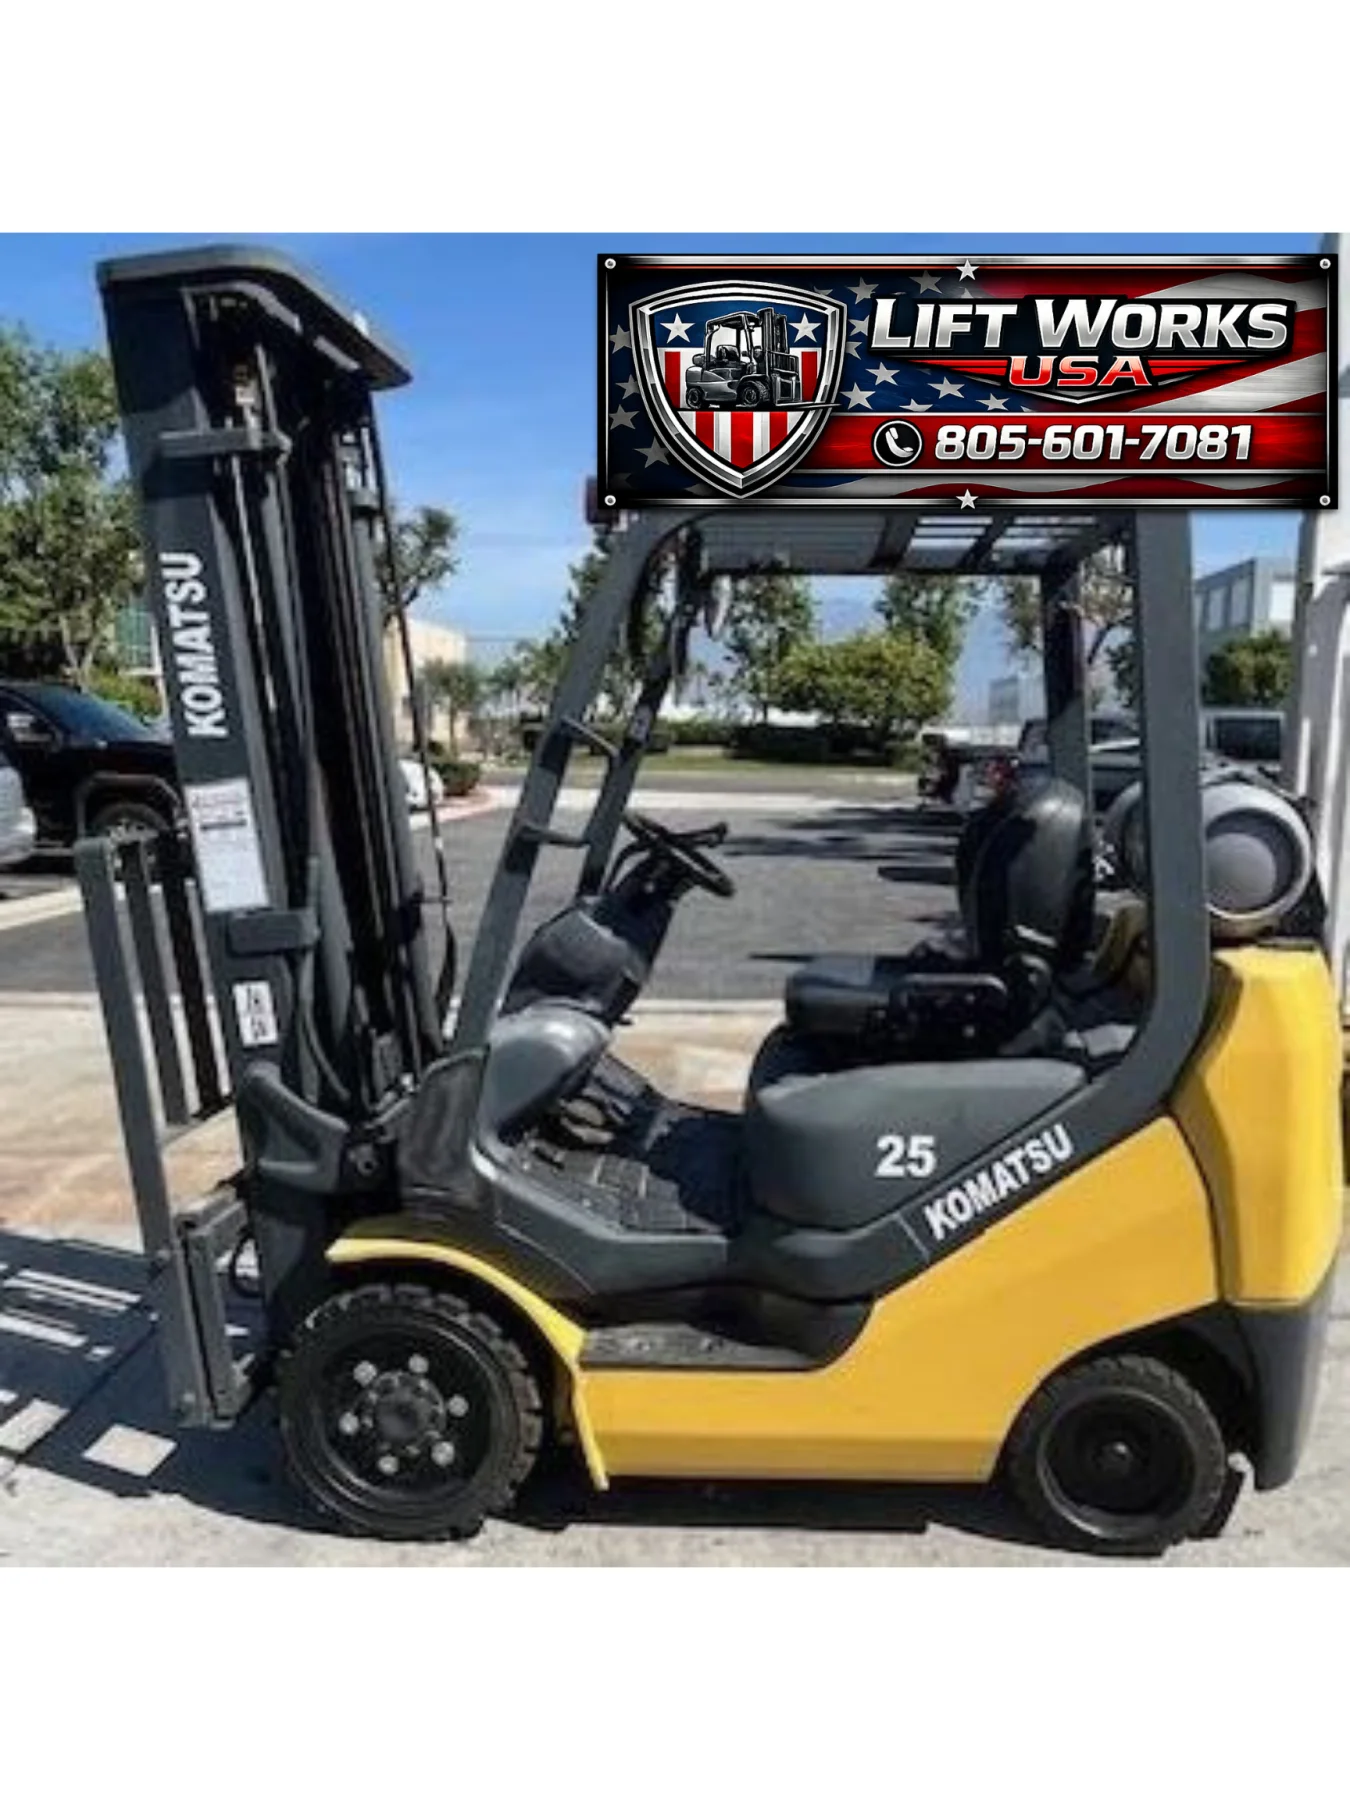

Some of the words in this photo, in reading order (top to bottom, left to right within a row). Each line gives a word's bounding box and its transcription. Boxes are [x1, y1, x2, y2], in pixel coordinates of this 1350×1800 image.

[159, 552, 229, 738] KOMATSU
[875, 1135, 937, 1178] 25
[924, 1123, 1074, 1240] KOMATSU
